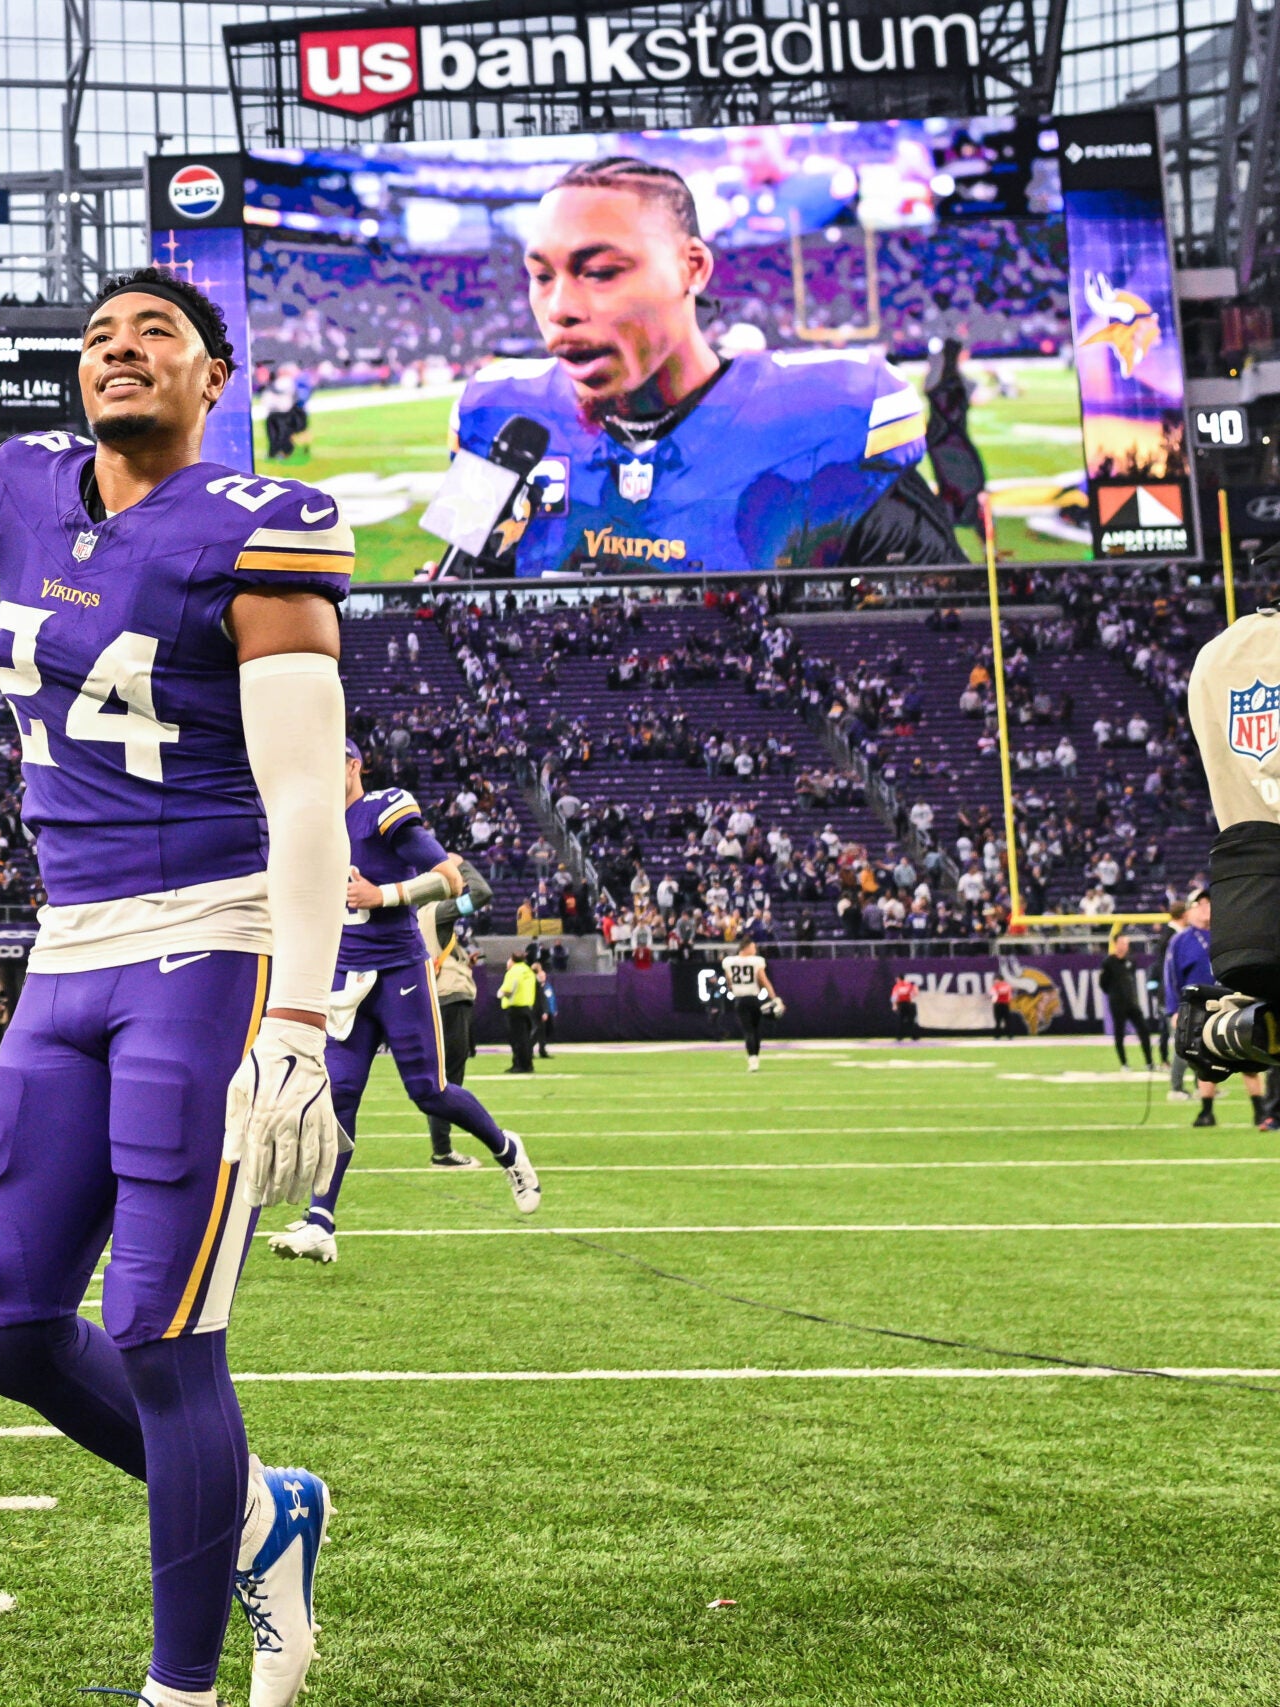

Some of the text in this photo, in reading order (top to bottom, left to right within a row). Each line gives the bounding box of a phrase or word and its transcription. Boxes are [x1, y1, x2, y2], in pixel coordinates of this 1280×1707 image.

[1084, 142, 1152, 158] PENTAIR
[173, 186, 220, 196] PEPSI
[1197, 410, 1243, 444] 40
[1101, 529, 1188, 546] ANDERSEN
[1234, 713, 1278, 752] NFL
[730, 965, 755, 984] 89
